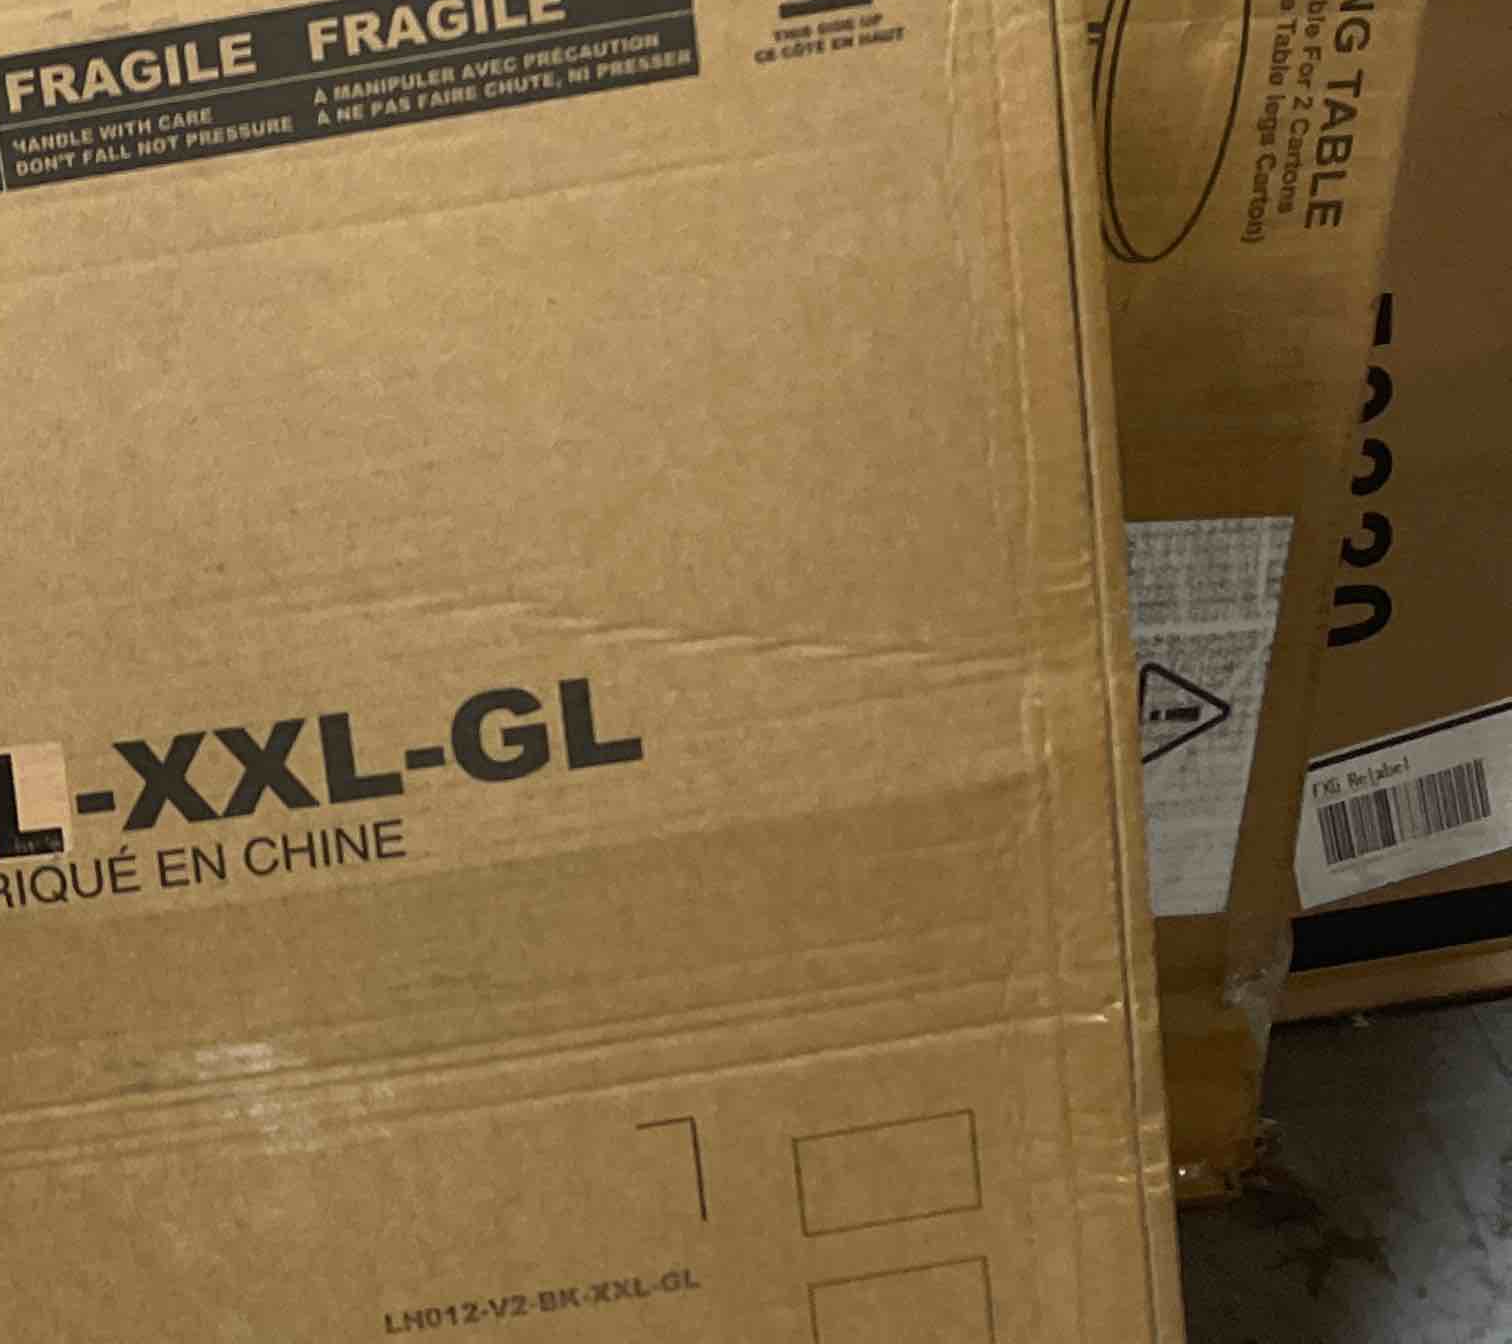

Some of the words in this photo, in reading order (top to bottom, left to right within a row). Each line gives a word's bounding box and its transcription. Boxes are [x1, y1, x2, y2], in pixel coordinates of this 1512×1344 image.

[4, 32, 256, 113] FRAGILE
[832, 35, 854, 51] EN
[1268, 19, 1297, 87] Table
[1297, 46, 1322, 89] For
[334, 68, 456, 101] MANIPULER
[462, 58, 518, 80] AVEC
[337, 102, 364, 124] NE
[371, 96, 412, 118] PAS
[417, 85, 477, 111] FAIRE
[483, 72, 564, 100] CHUTE,
[568, 66, 591, 84] NI
[596, 48, 692, 79] PRESSER
[1292, 96, 1313, 111] 2
[12, 126, 94, 154] HANDLE
[99, 118, 152, 140] WITH
[158, 107, 214, 130] CARE
[15, 152, 76, 177] DON'T
[83, 144, 131, 166] FALL
[137, 135, 180, 157] NOT
[187, 115, 294, 147] PRESSURE
[1303, 69, 1364, 229] TABLE
[1240, 152, 1278, 244] Carton)
[1277, 117, 1310, 214] Cartons
[156, 840, 228, 890] EN
[243, 818, 407, 876] CHINE
[384, 1265, 702, 1336] LH012-V2-BK-XXL-GL
